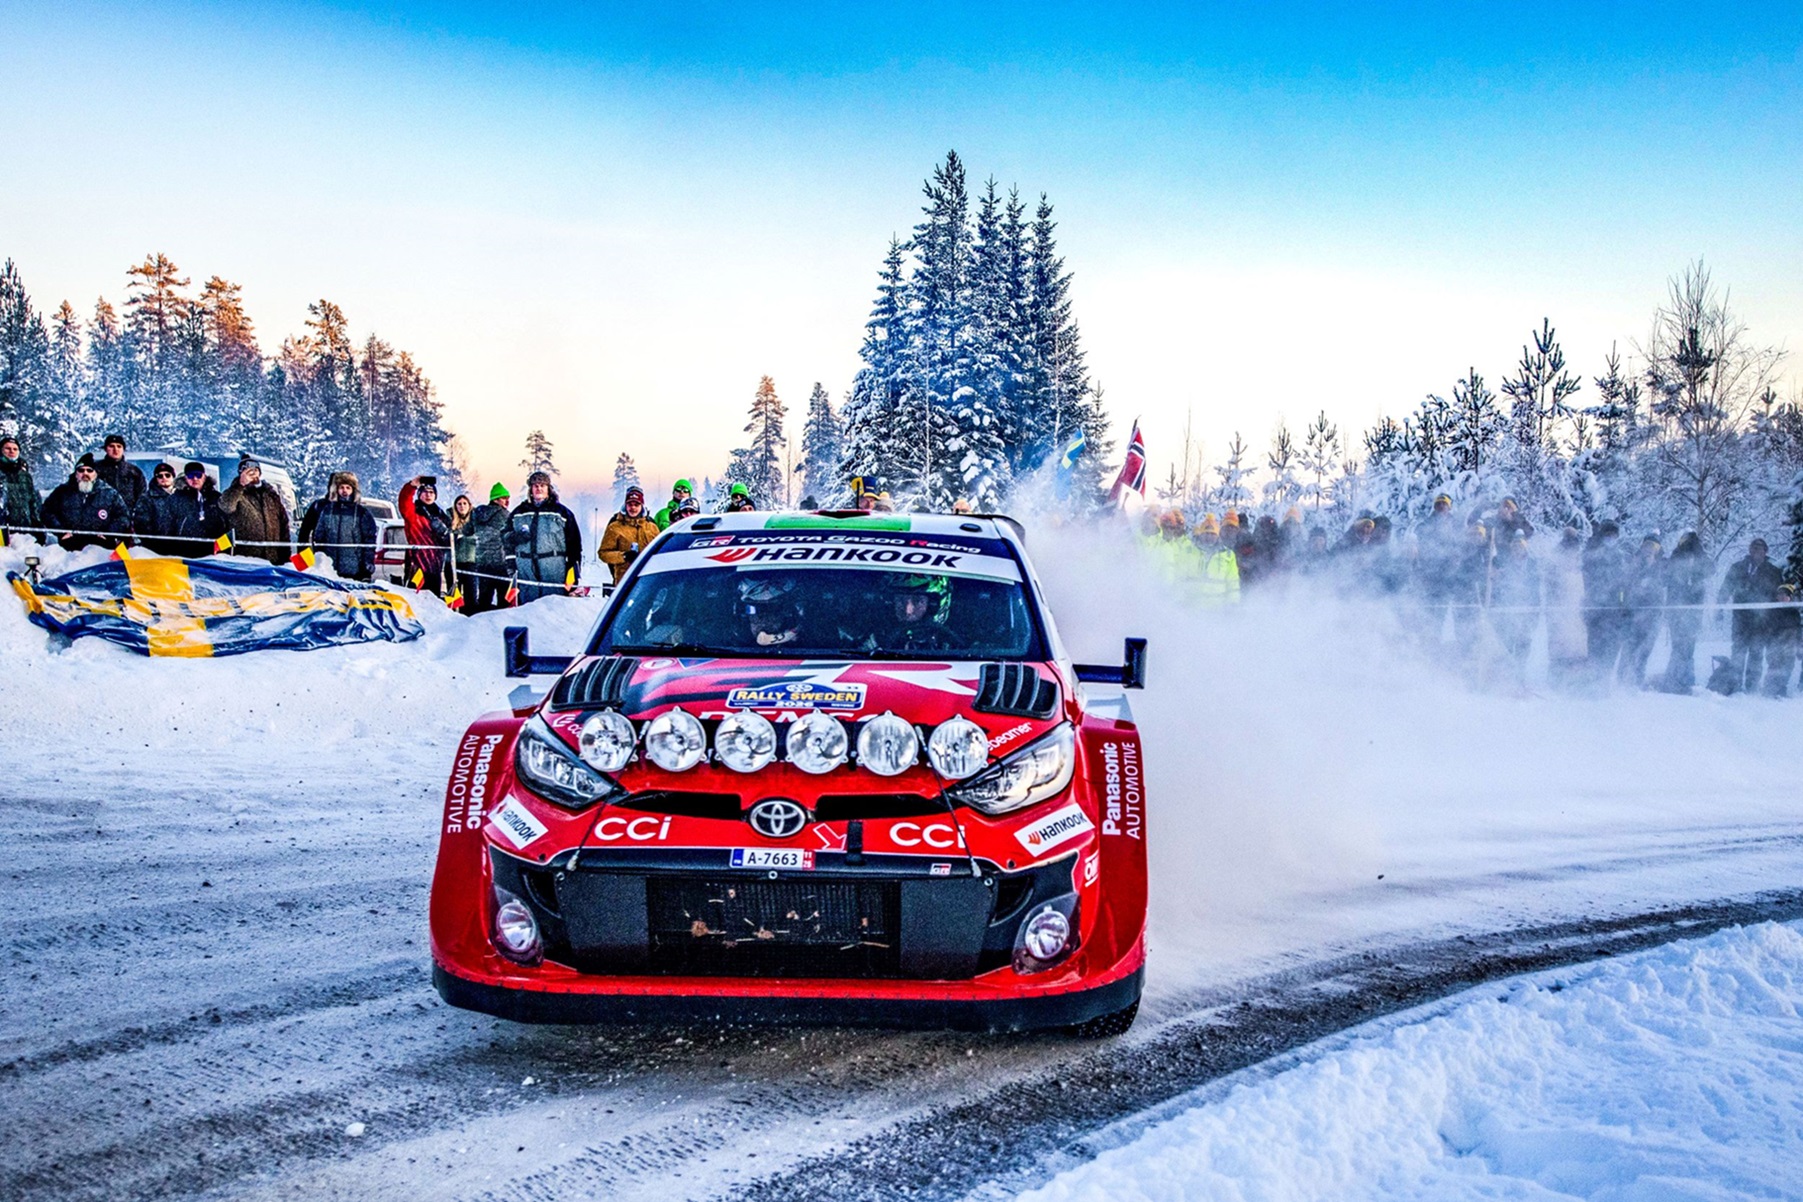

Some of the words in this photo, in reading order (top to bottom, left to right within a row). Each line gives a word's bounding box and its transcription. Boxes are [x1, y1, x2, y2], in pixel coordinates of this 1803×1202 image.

[738, 535, 822, 544] TOYOTA
[825, 535, 906, 545] GAZOO
[909, 539, 982, 554] Racing
[736, 690, 786, 701] RALLY
[790, 692, 858, 702] SWEDEN
[447, 734, 481, 834] AUTOMOTIVE
[466, 734, 504, 829] Panasonic
[1099, 742, 1121, 836] Panasonic
[1121, 741, 1141, 840] AUTOMOTIVE
[747, 852, 798, 865] A-7663
